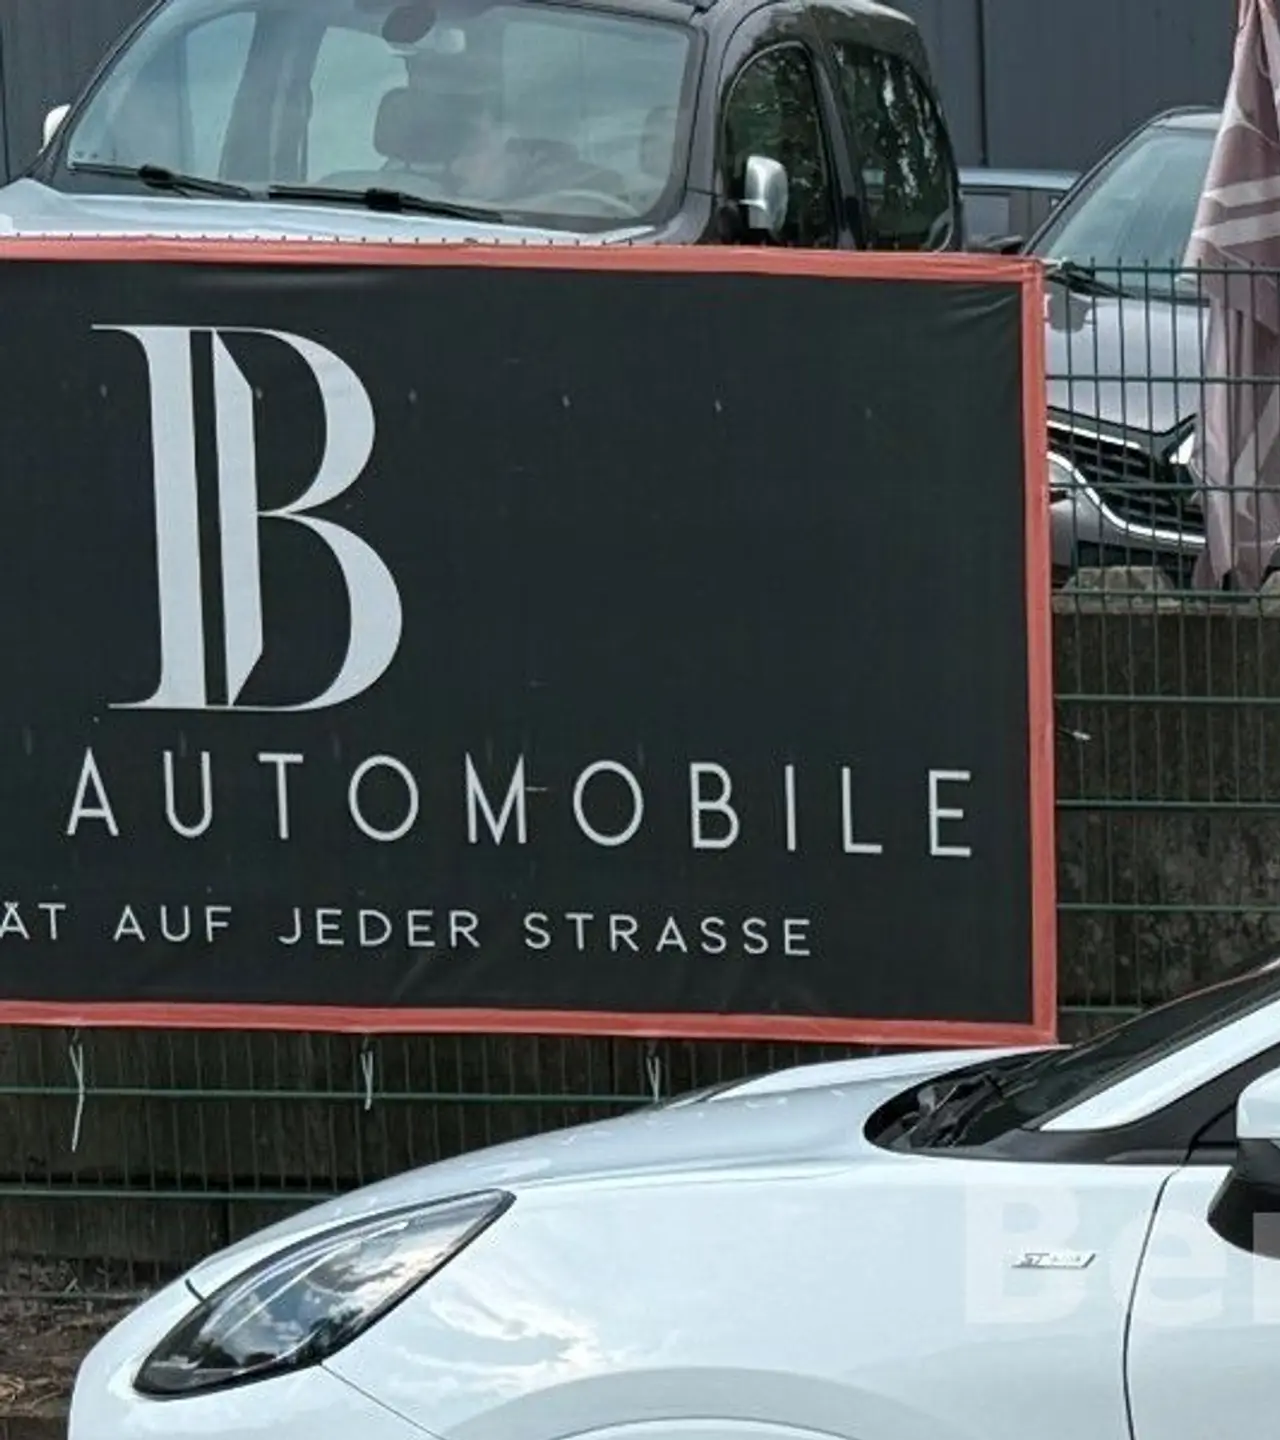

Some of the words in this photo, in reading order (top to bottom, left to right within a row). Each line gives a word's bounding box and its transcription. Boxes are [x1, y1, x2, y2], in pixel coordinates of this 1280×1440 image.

[66, 747, 971, 858] AUTOMOBILE
[113, 904, 232, 943] AUF
[278, 907, 480, 948] JEDER
[523, 912, 812, 956] STRASSE
